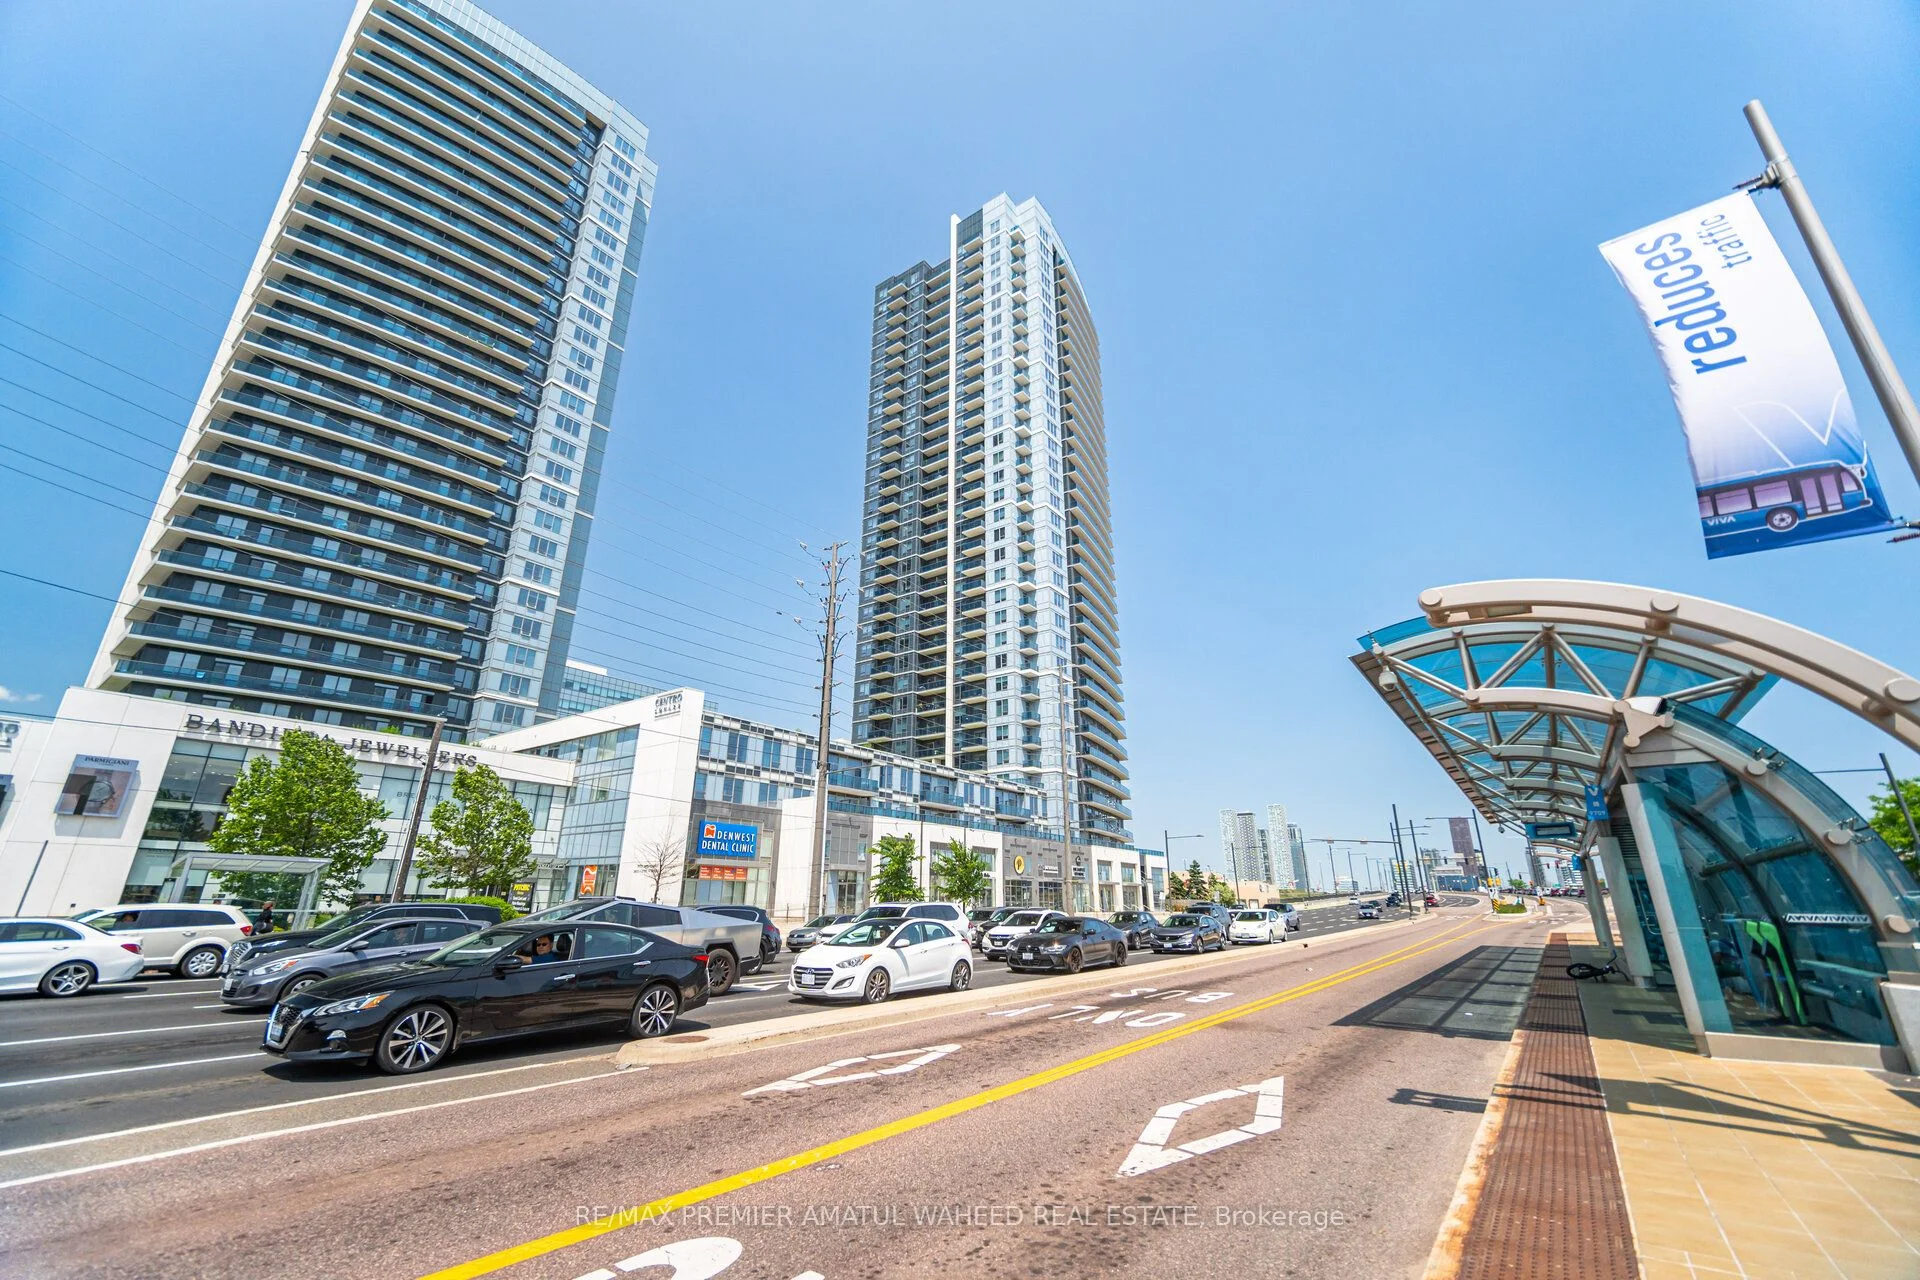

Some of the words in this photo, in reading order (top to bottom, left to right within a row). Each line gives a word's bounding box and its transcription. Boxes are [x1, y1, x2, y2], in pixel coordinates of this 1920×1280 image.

[1696, 214, 1752, 269] traffic
[1635, 232, 1747, 374] reduces
[1707, 516, 1736, 526] VIVA
[344, 737, 477, 768] JEWELERS
[85, 756, 130, 766] PARMIGIANI
[717, 831, 755, 842] DENWEST
[701, 840, 729, 851] DENTAL
[731, 842, 754, 853] CLINIC
[1110, 987, 1235, 1003] BUS
[987, 1003, 1186, 1027] ONLY
